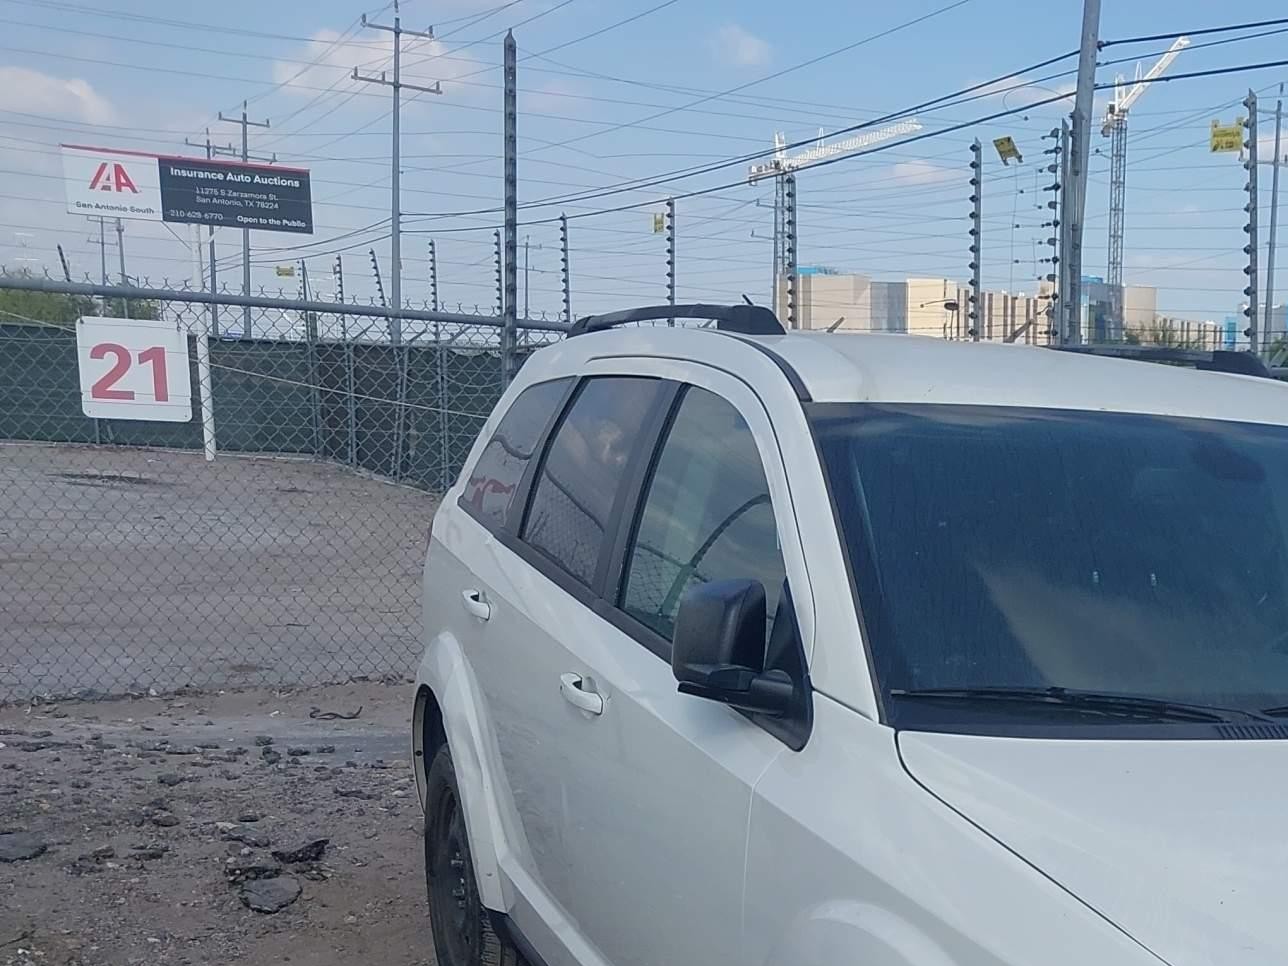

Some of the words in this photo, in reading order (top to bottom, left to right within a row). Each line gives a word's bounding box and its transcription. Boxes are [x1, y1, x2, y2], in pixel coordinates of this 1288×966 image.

[170, 167, 224, 180] Insurance
[226, 172, 251, 183] Auto
[253, 175, 300, 187] Auctions
[196, 195, 211, 203] San
[75, 201, 93, 209] San
[94, 202, 128, 212] Antonio
[129, 206, 155, 214] South
[236, 215, 258, 224] Open
[90, 342, 169, 402] 21
